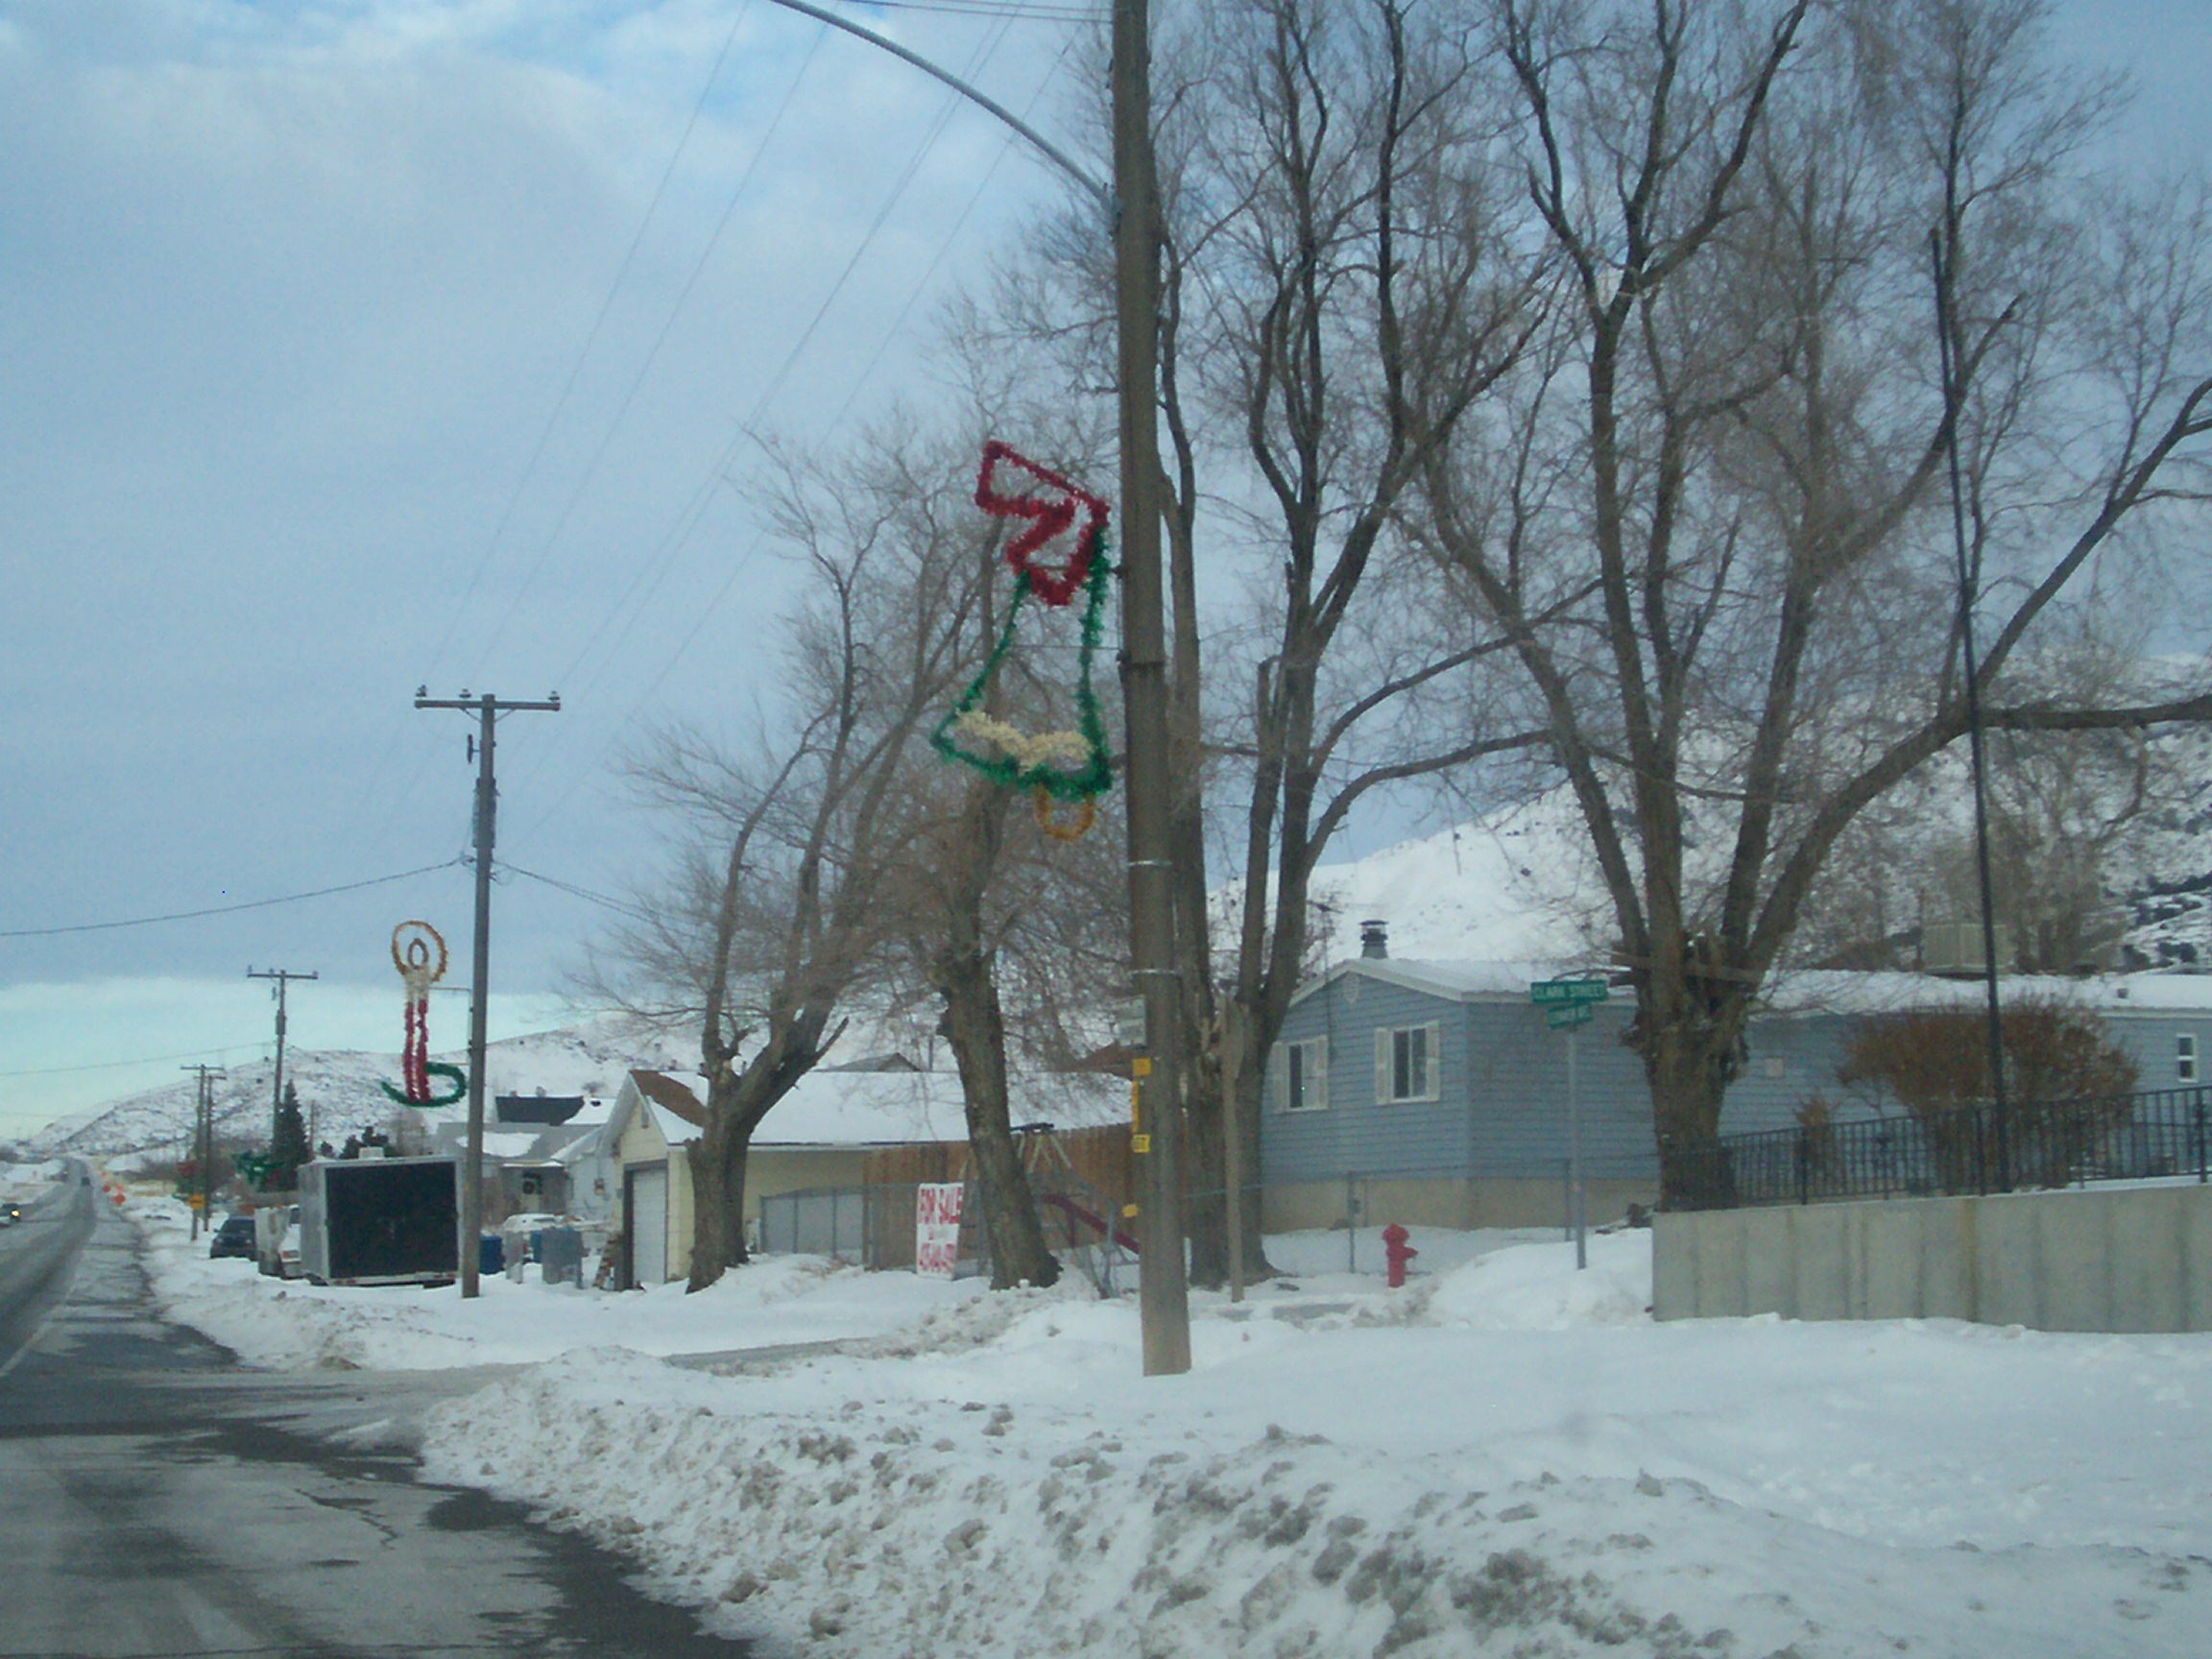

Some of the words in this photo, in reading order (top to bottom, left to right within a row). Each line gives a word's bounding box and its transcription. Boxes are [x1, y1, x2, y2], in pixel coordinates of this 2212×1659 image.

[1533, 985, 1566, 999] CLARK
[1569, 983, 1604, 998] STREET
[919, 1189, 936, 1225] FOR
[938, 1187, 963, 1225] SALE
